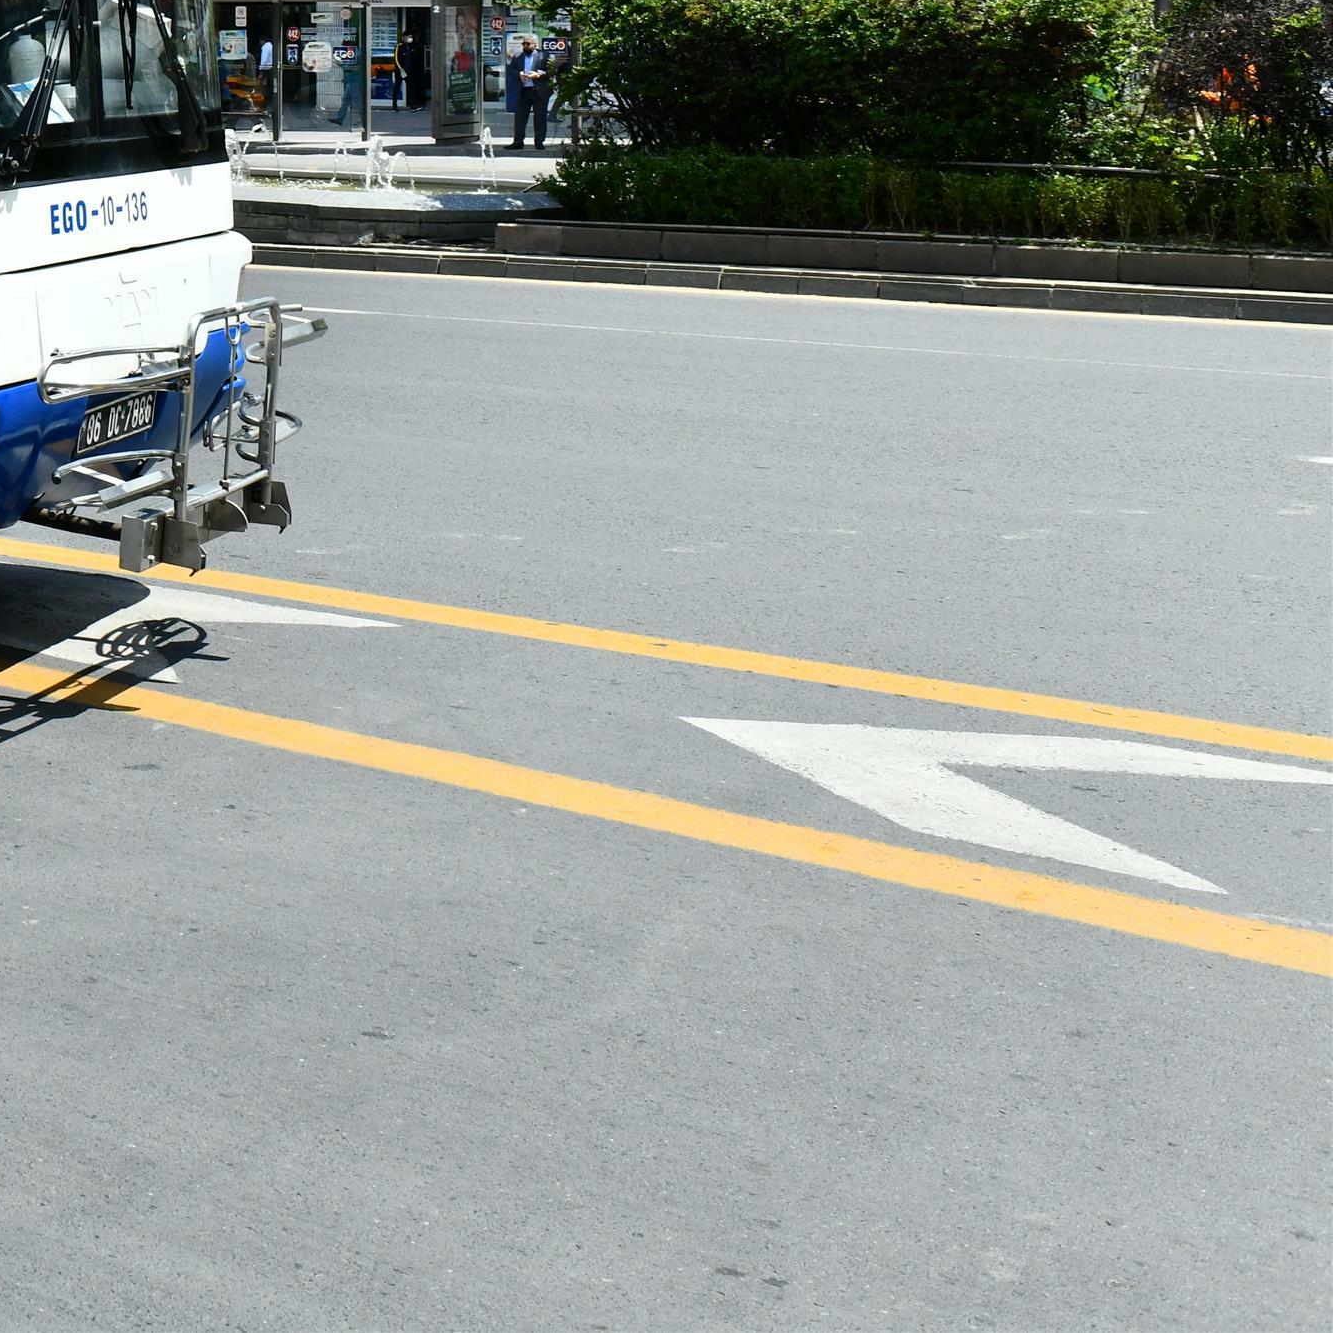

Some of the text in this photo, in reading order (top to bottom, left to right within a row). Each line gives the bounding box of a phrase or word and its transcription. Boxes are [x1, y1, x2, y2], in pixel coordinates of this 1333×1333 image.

[433, 5, 440, 13] 2
[490, 19, 503, 29] 442
[543, 41, 566, 51] EGO
[107, 404, 122, 438] DC
